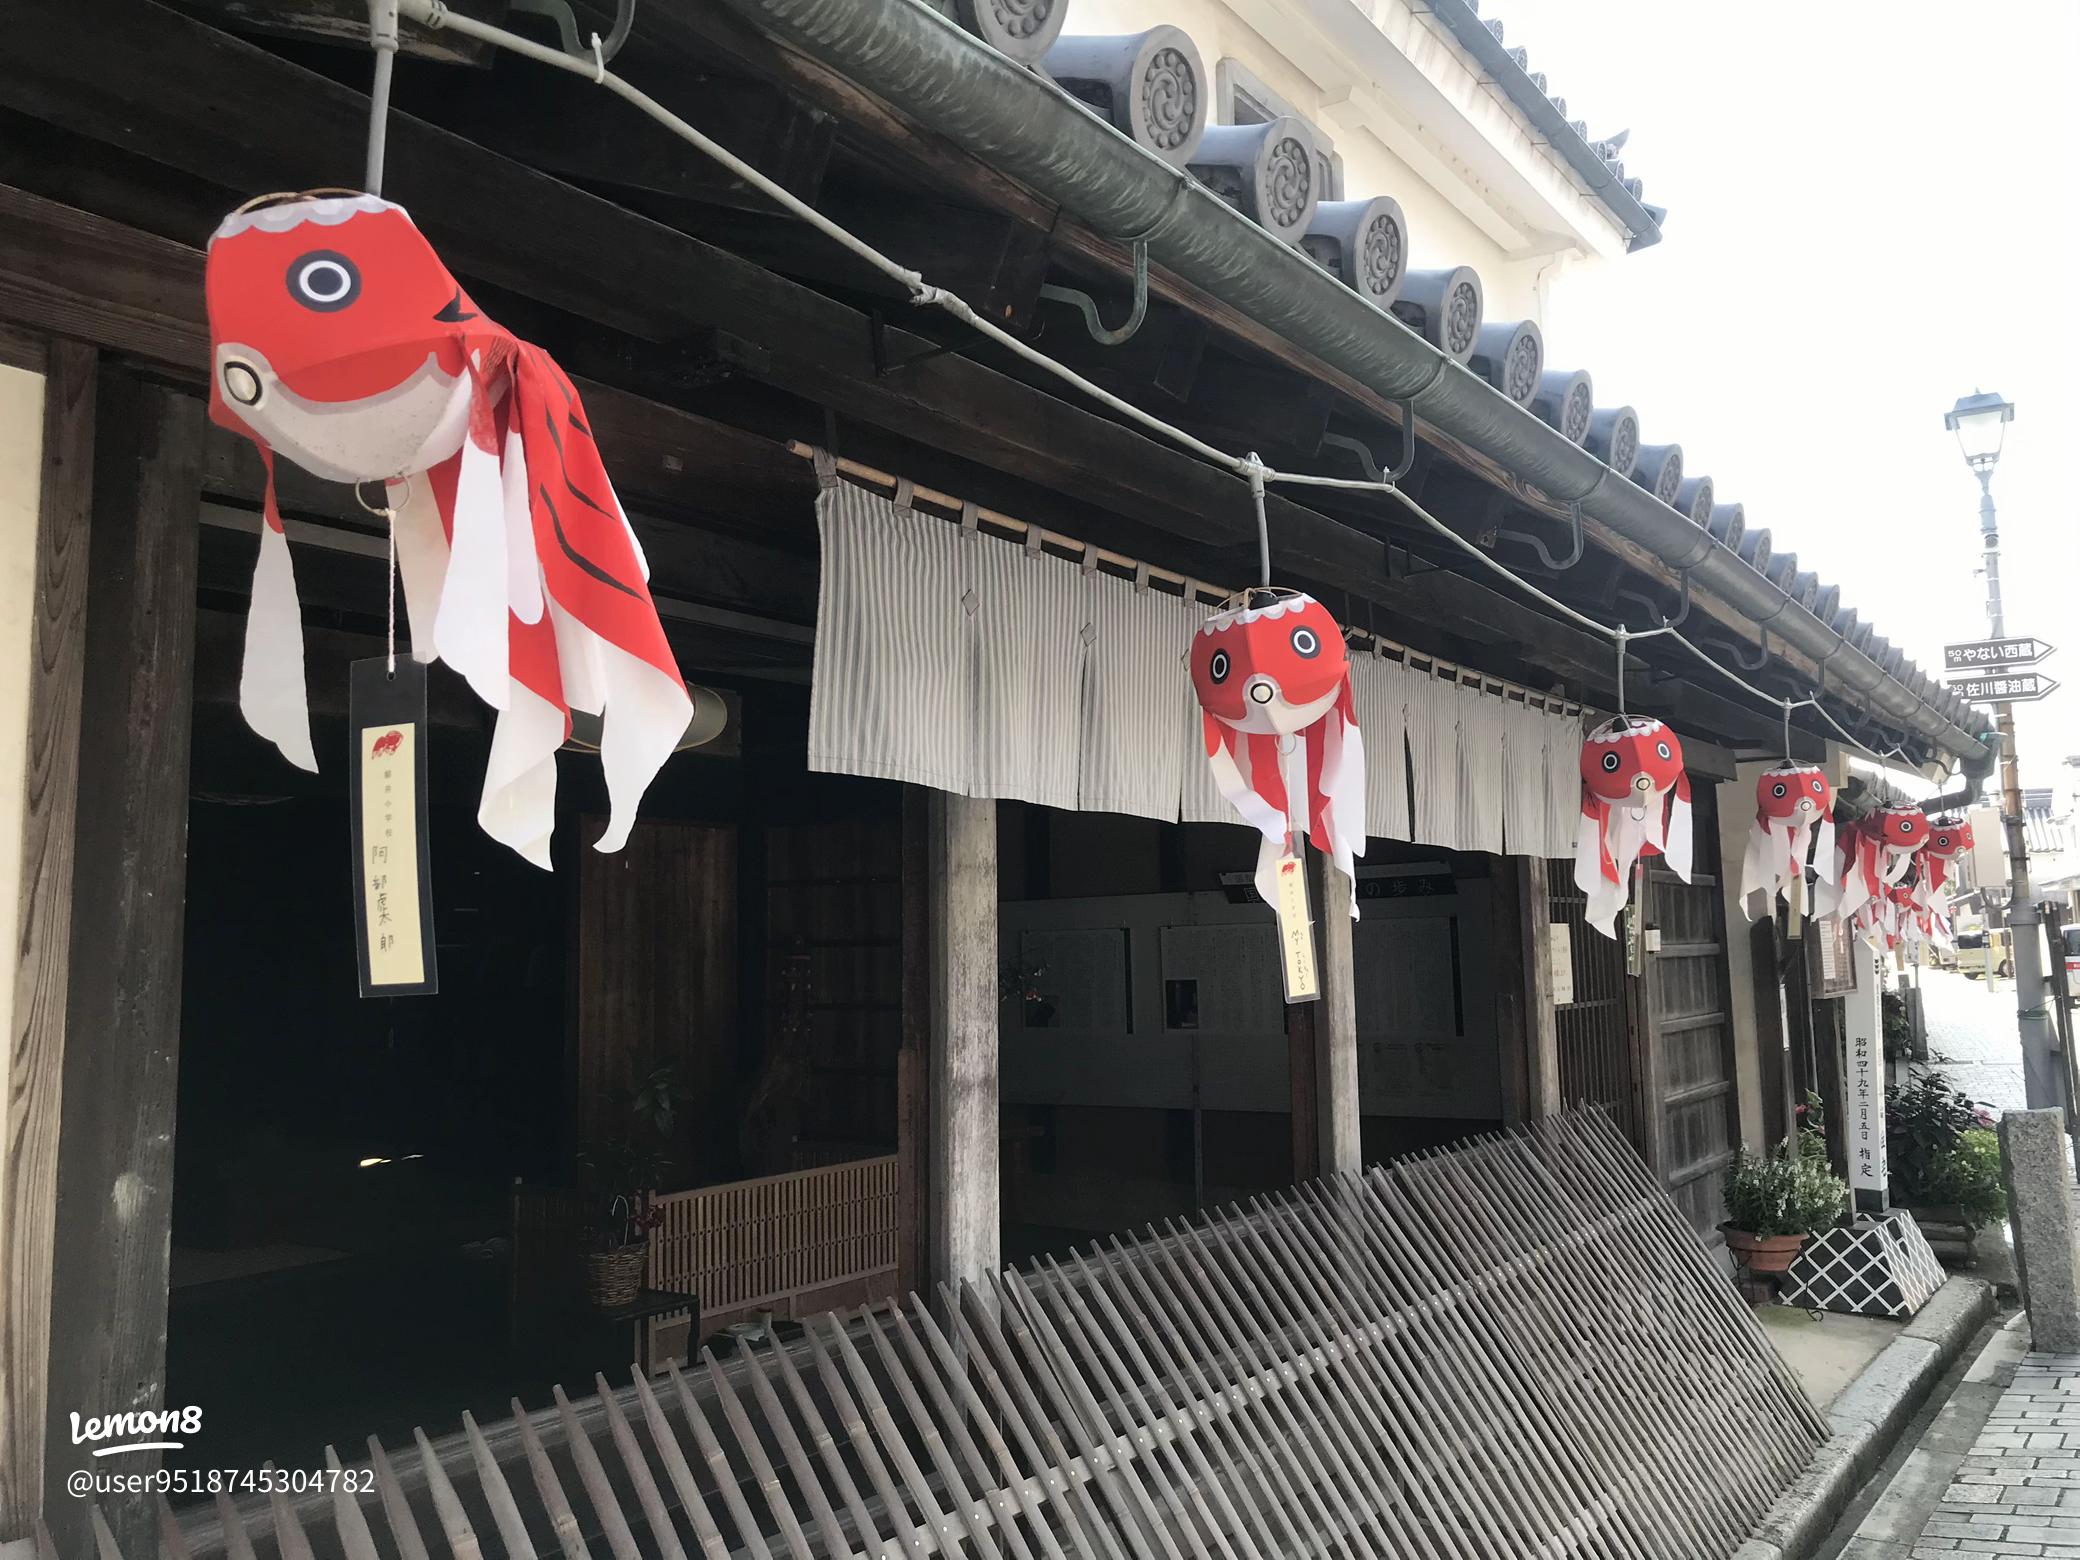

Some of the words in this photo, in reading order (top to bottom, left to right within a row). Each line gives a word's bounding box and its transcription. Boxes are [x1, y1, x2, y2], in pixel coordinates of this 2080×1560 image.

[1963, 643, 2033, 661] やない西蔵
[1855, 1037, 1870, 1140] 昭和四十九年二月五日
[1859, 1147, 1873, 1177] 指定
